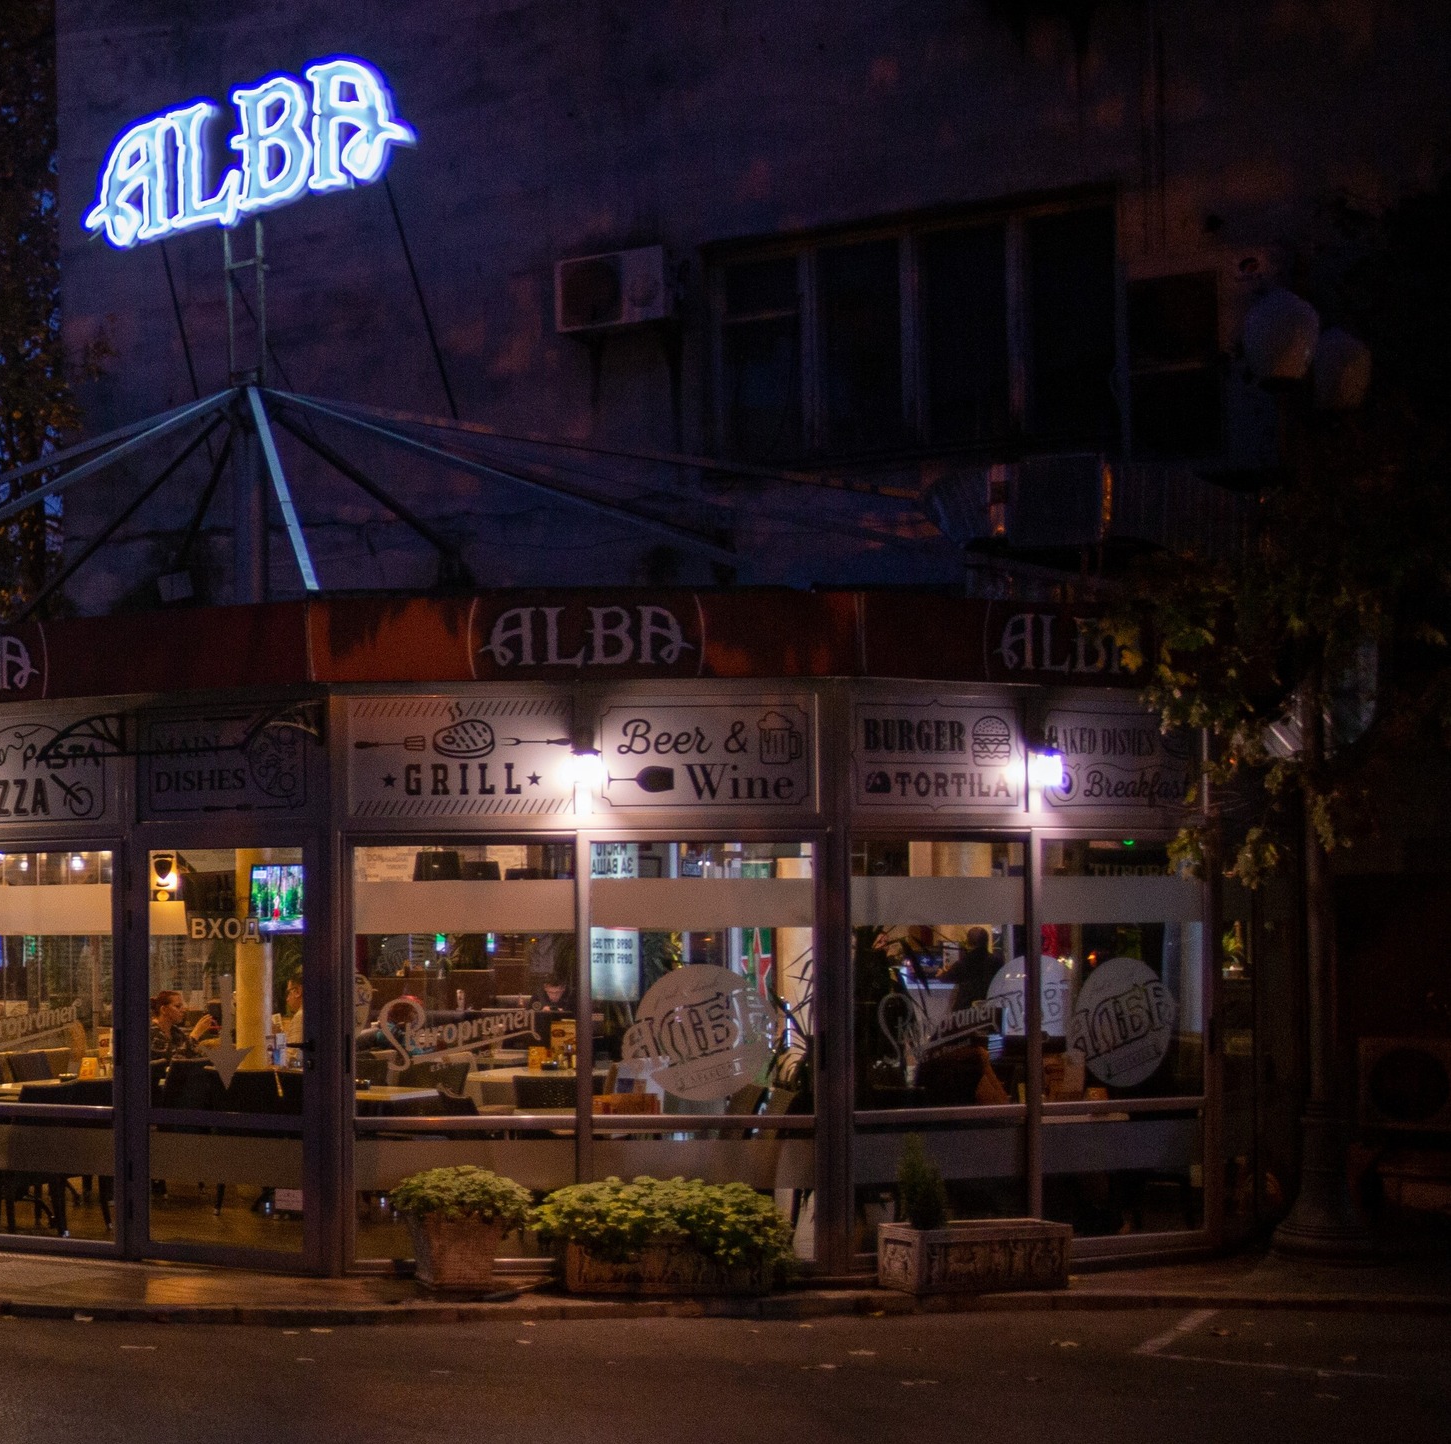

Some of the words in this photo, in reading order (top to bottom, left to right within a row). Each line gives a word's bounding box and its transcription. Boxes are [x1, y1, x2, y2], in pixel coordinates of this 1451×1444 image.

[84, 56, 416, 246] ALBA
[478, 604, 695, 667] ALBA
[616, 718, 714, 755] Beer
[723, 720, 749, 755] &
[863, 718, 968, 753] BURGER
[155, 768, 246, 793] DISHES
[404, 762, 522, 796] GRILL
[683, 763, 796, 800] Wine
[893, 770, 1012, 799] TORTILA
[1083, 769, 1191, 806] Breakfast
[190, 917, 261, 944] ВХОД
